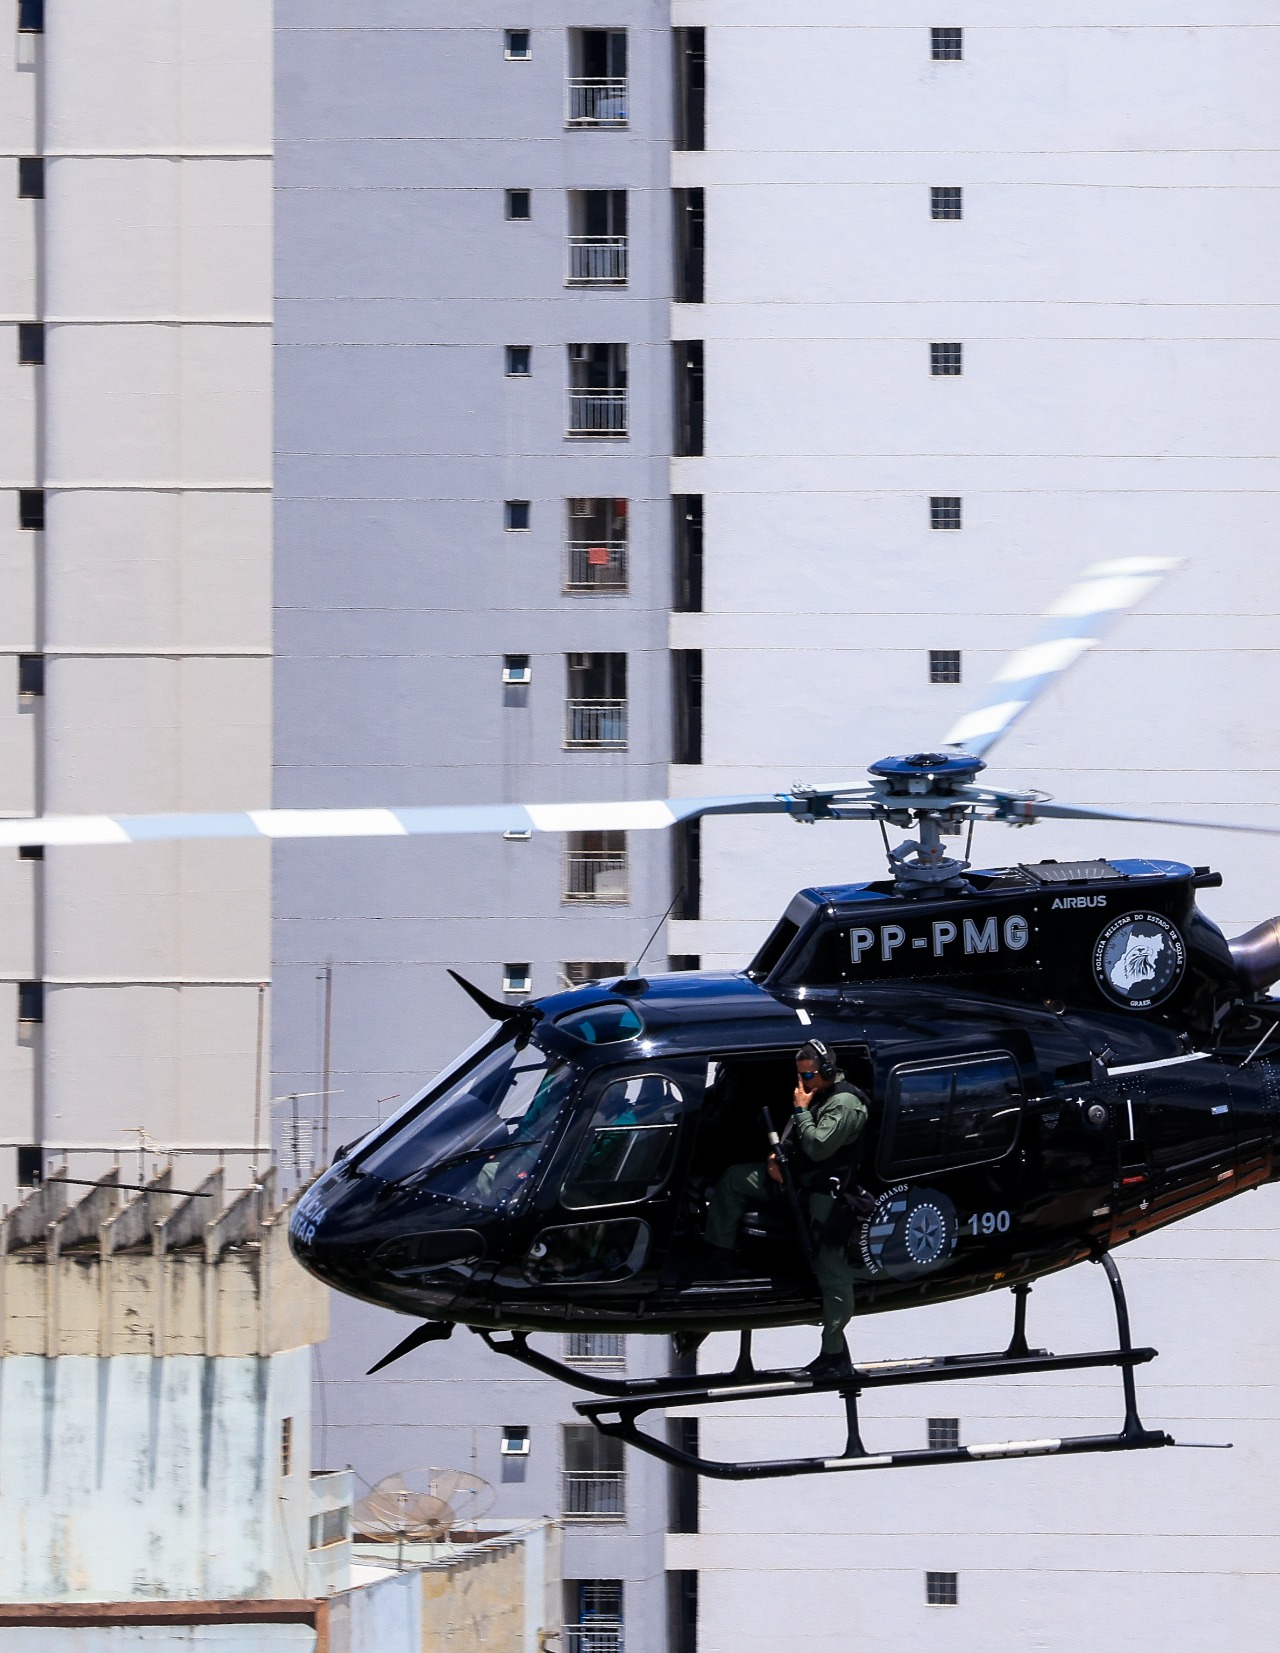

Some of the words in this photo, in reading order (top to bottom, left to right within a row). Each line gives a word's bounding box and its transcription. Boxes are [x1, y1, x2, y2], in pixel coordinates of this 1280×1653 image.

[1051, 895, 1107, 910] AIRBUS
[849, 914, 1030, 965] PP-PMG
[874, 1183, 909, 1207] GOIANOS
[967, 1210, 1011, 1236] 190
